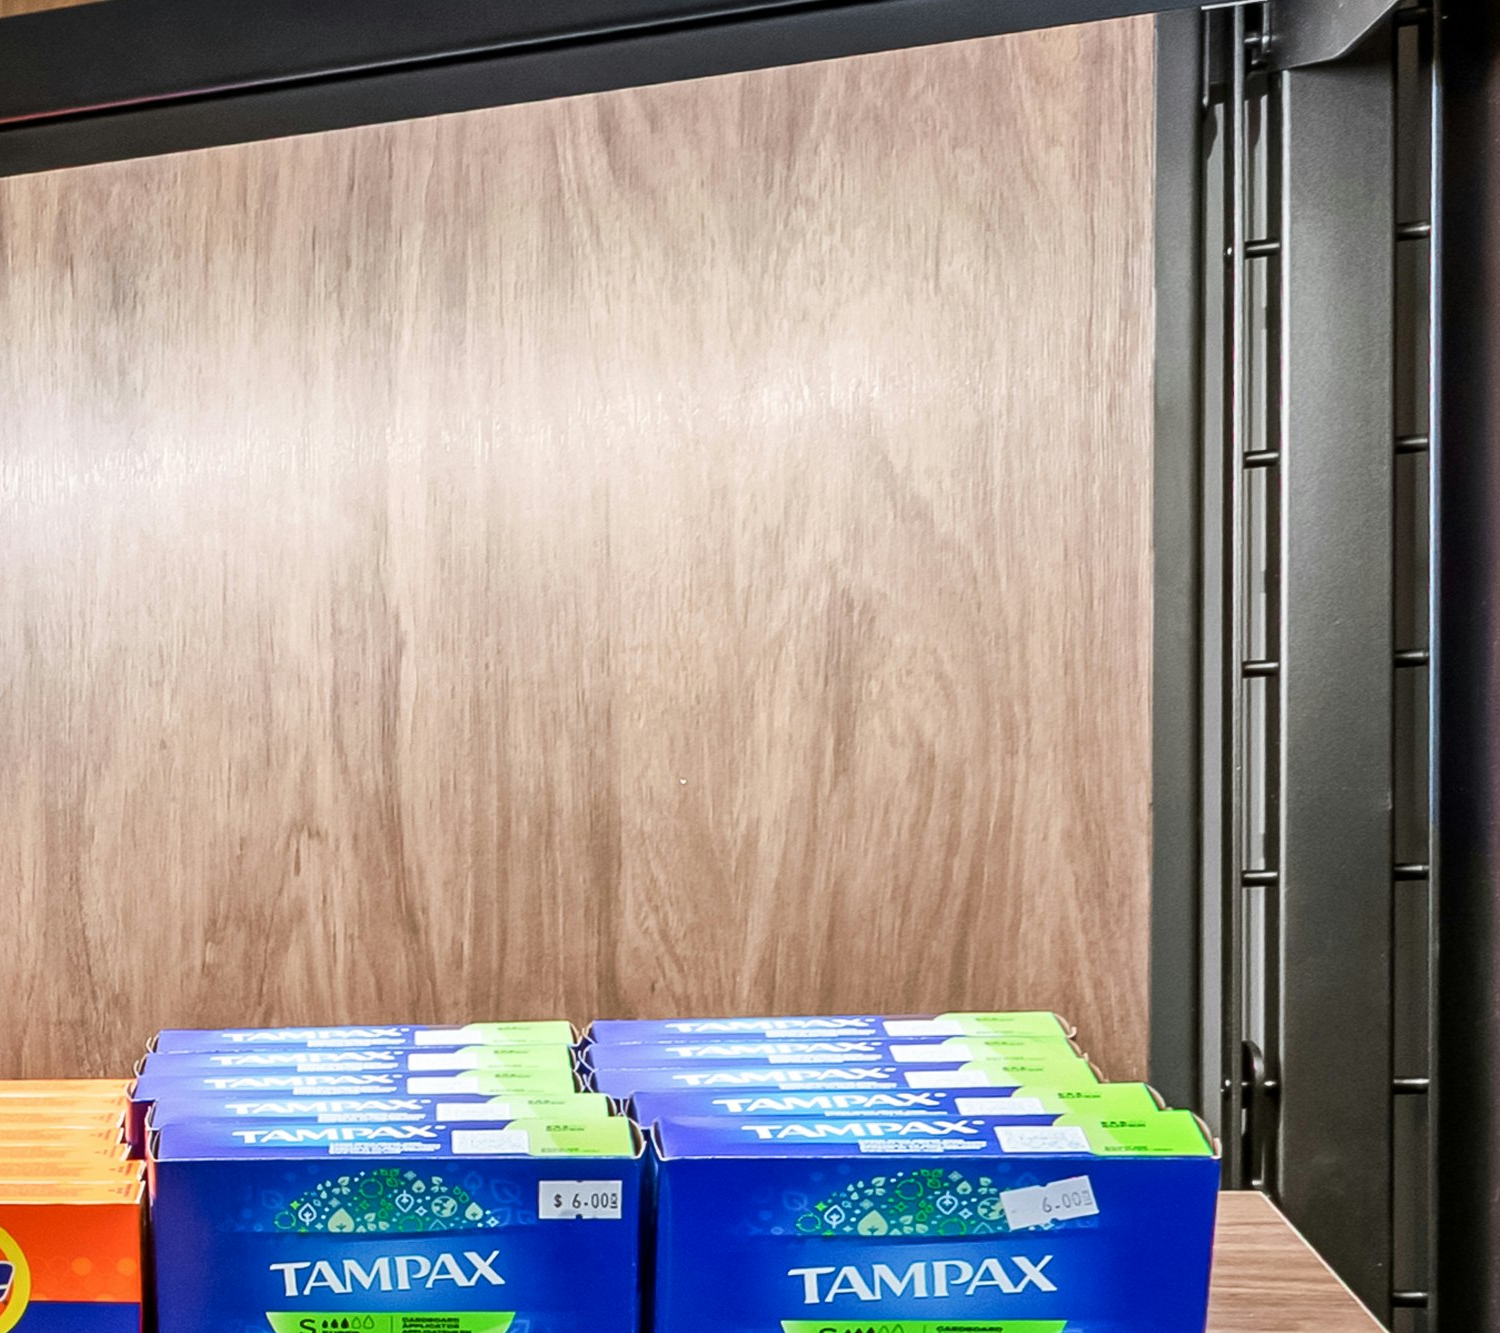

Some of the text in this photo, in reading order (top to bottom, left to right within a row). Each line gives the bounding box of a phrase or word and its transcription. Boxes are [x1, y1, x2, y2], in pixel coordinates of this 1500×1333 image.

[232, 1125, 438, 1144] TAMPAX
[741, 1119, 976, 1140] TAMPAX
[269, 1249, 506, 1298] TAMPAX
[786, 1254, 1059, 1305] TAMPAX
